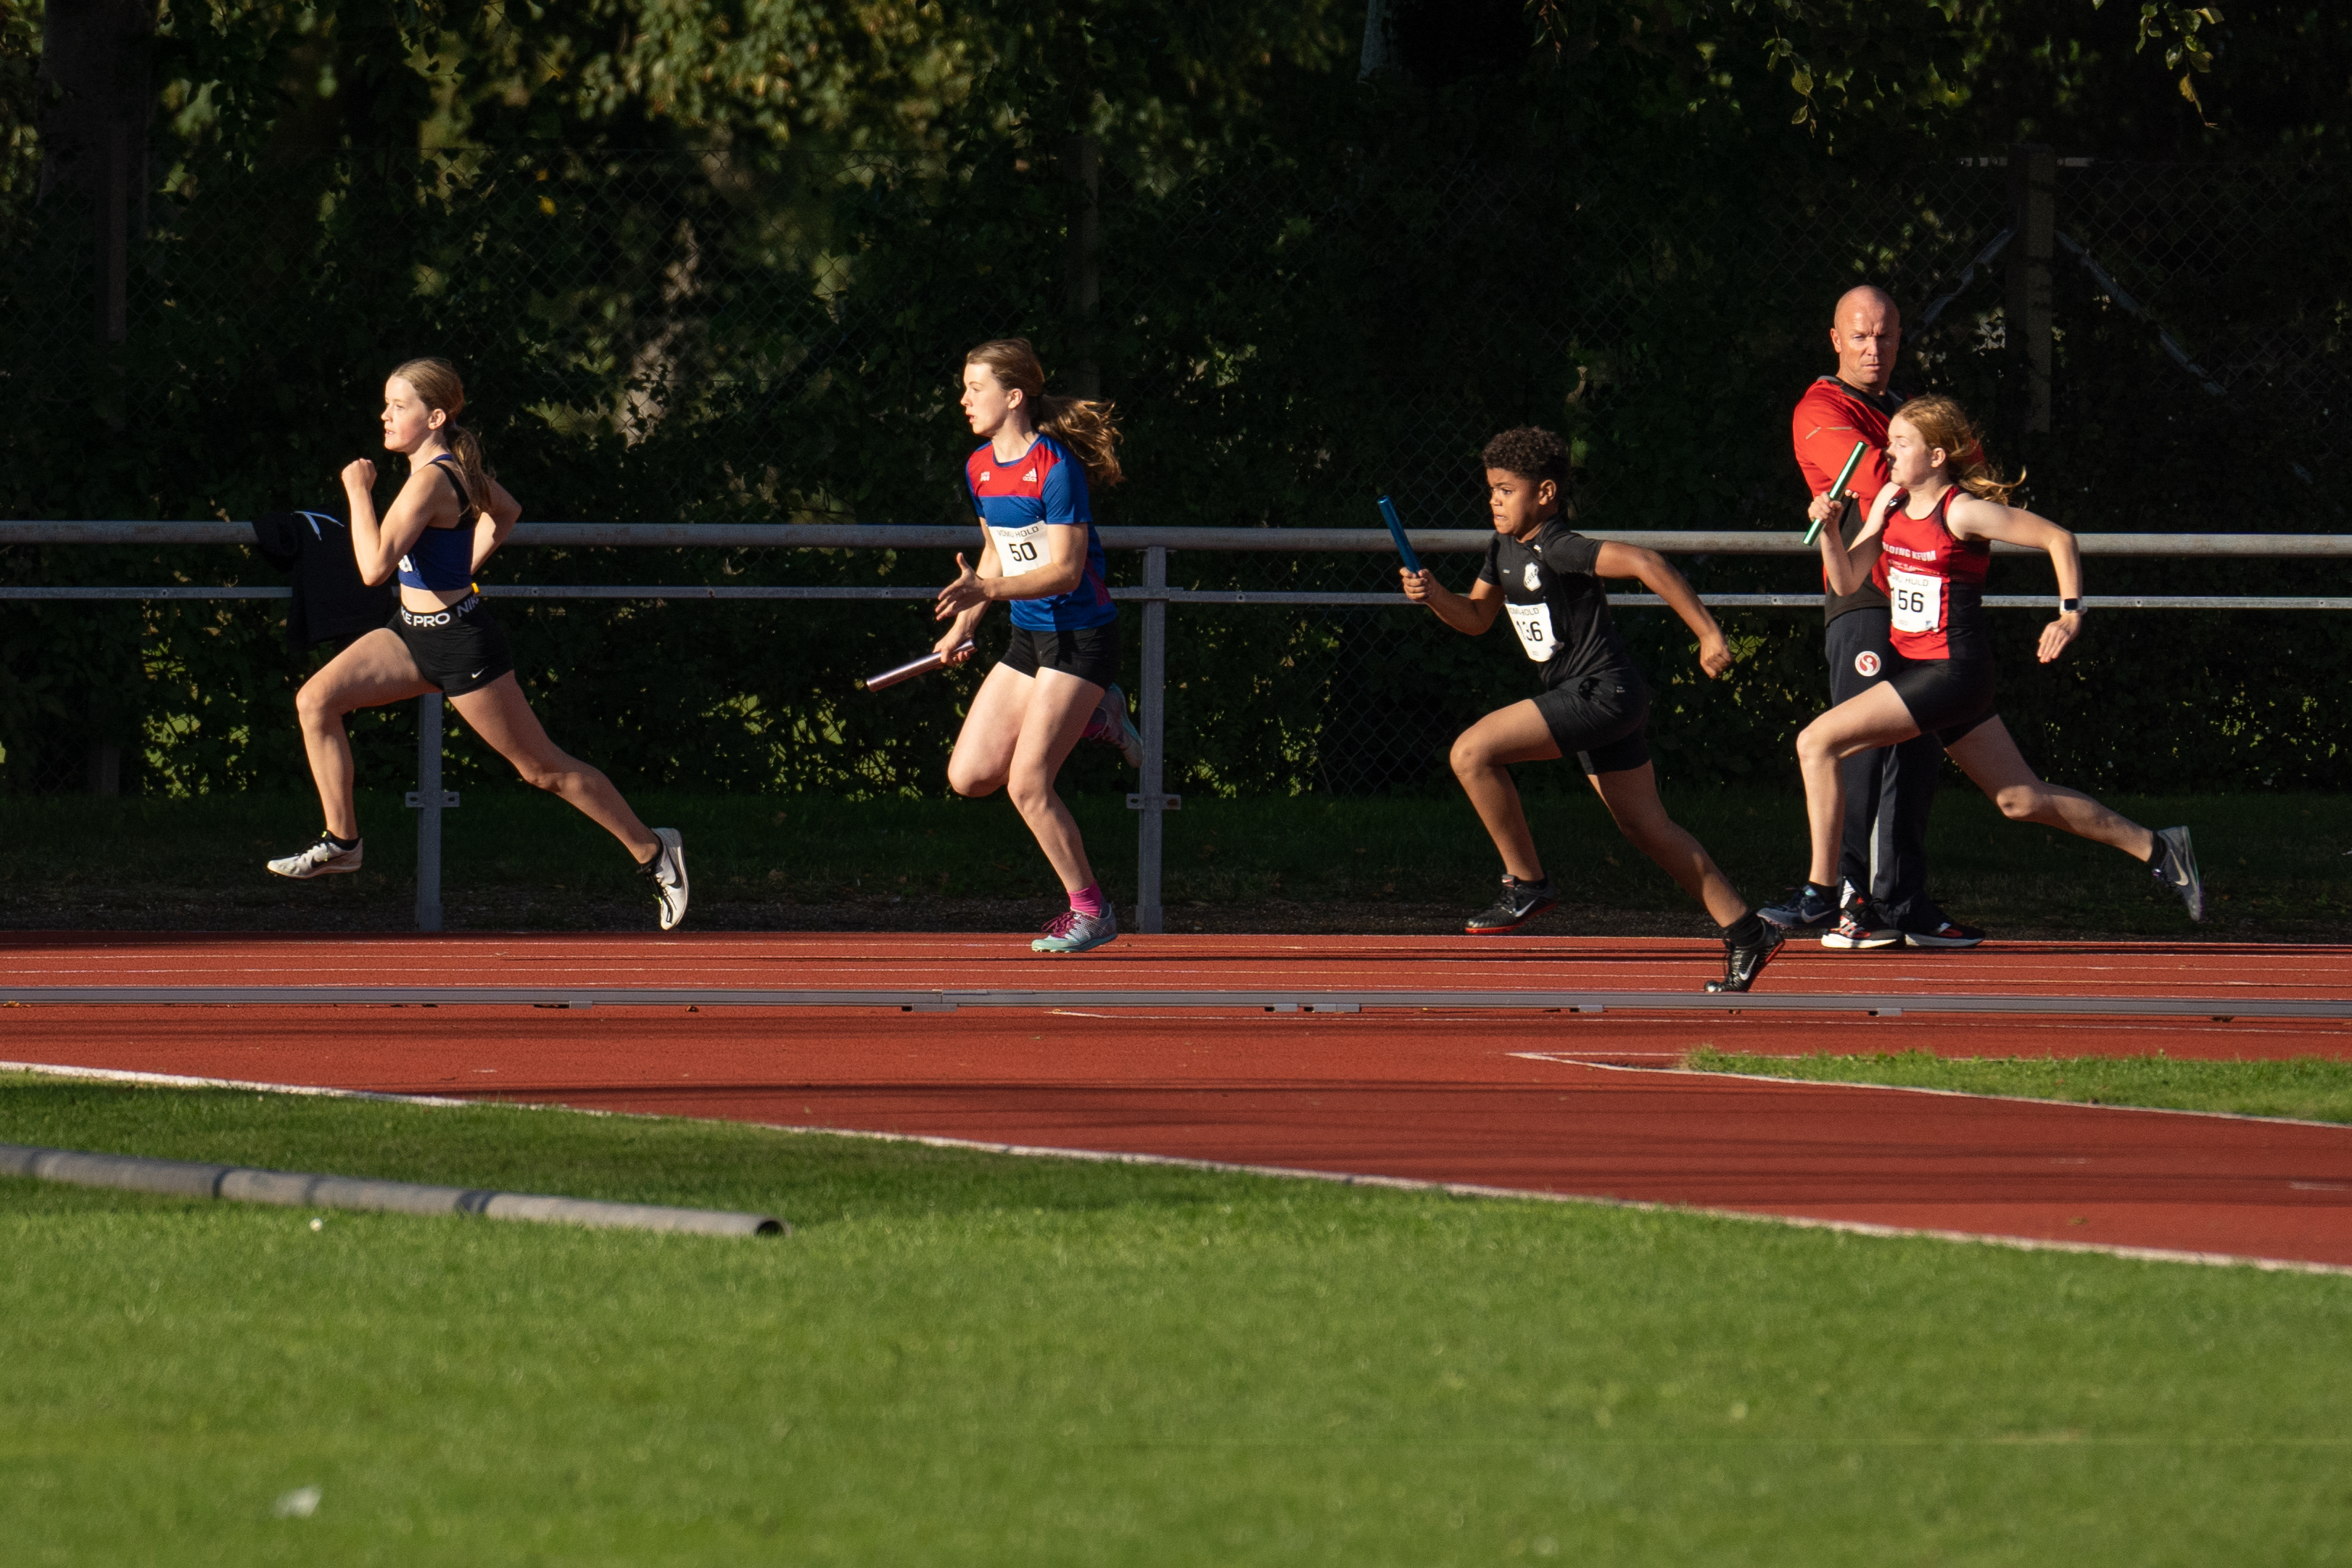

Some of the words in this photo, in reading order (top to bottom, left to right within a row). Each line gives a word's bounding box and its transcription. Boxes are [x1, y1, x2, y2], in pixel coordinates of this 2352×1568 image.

[1015, 526, 1039, 537] HOLD
[1009, 541, 1038, 562] 50
[1905, 577, 1929, 587] HOLD
[1891, 586, 1924, 613] 156
[413, 612, 450, 627] PRO
